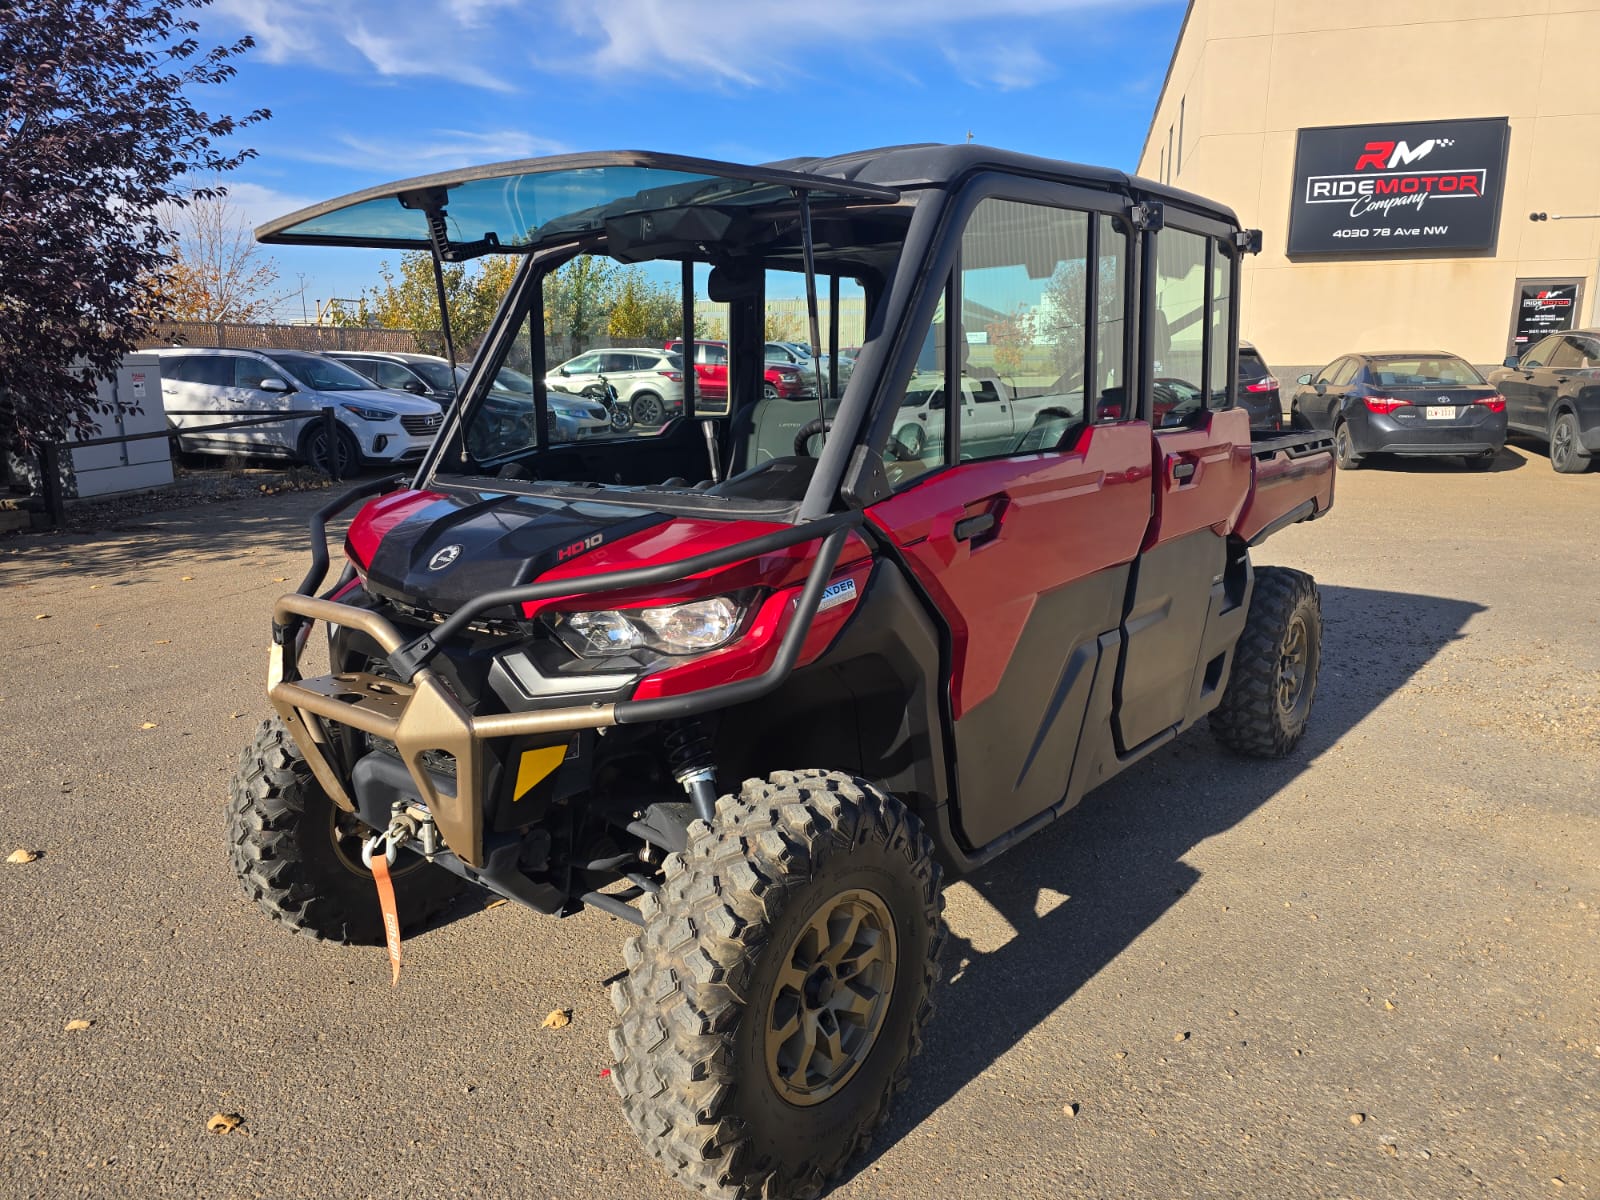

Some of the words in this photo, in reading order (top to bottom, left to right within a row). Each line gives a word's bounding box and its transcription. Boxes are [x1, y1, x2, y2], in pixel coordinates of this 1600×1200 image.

[1355, 139, 1436, 170] RM
[1313, 175, 1482, 197] RIDEMOTOR
[1350, 191, 1428, 217] Company
[1332, 229, 1369, 238] 4030
[1372, 228, 1391, 237] 78
[1393, 227, 1421, 236] Ave
[1423, 226, 1449, 235] NW
[558, 533, 603, 561] HD10
